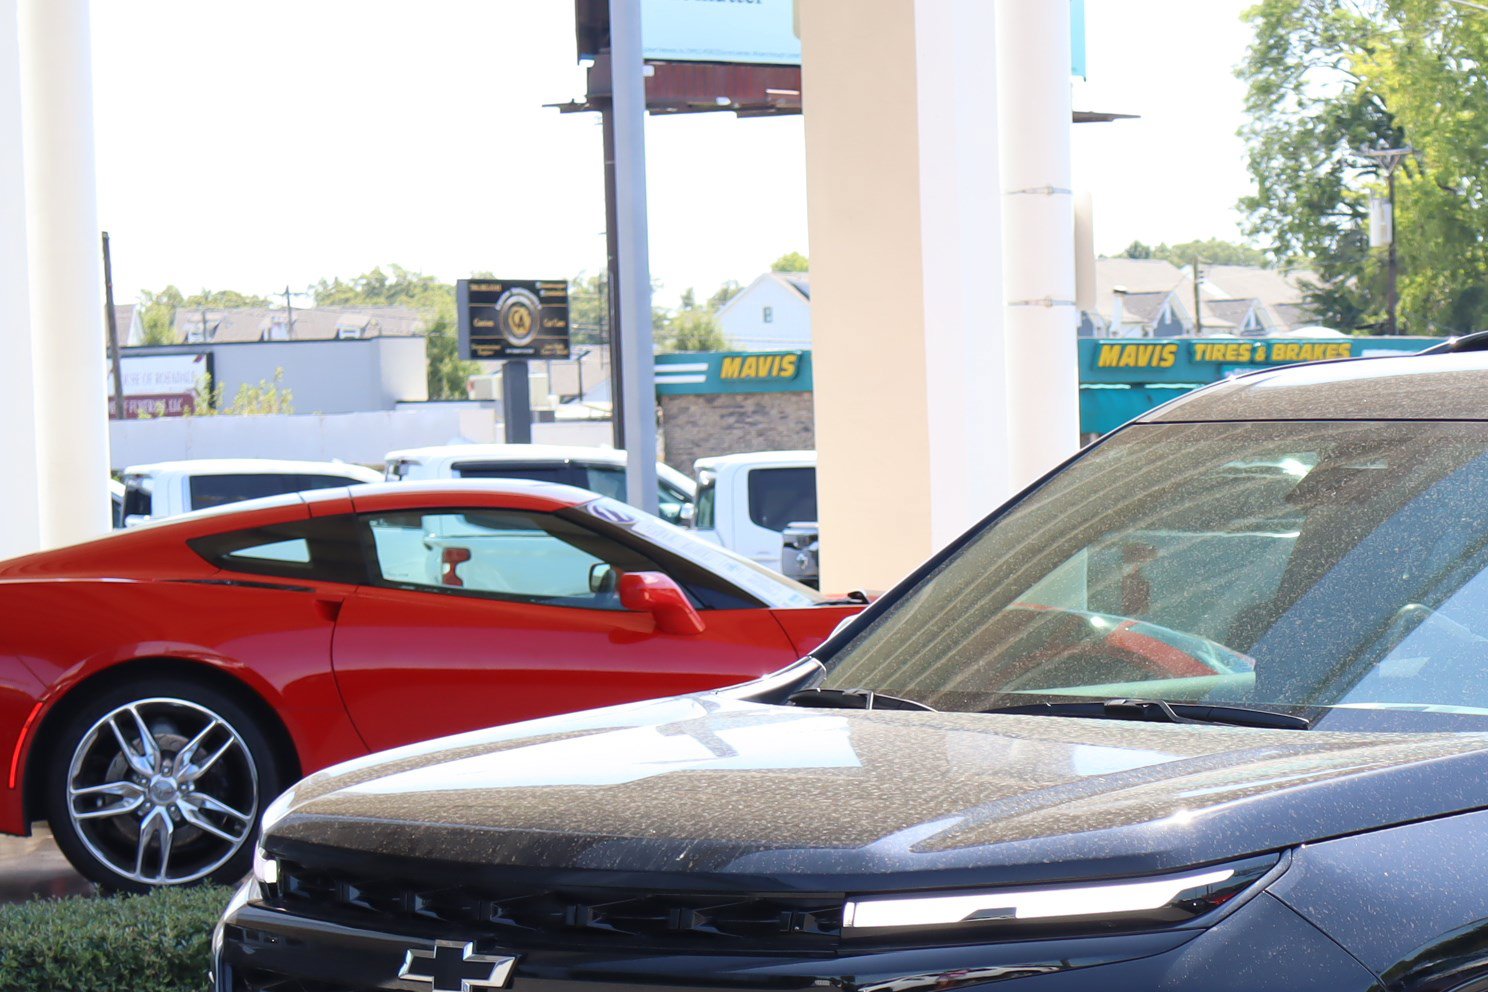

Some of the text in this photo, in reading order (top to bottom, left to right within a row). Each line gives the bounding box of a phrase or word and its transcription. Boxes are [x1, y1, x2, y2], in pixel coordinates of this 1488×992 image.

[720, 354, 797, 379] MAVIS
[1098, 342, 1352, 368] MAVIS TIRES & BRAKES
